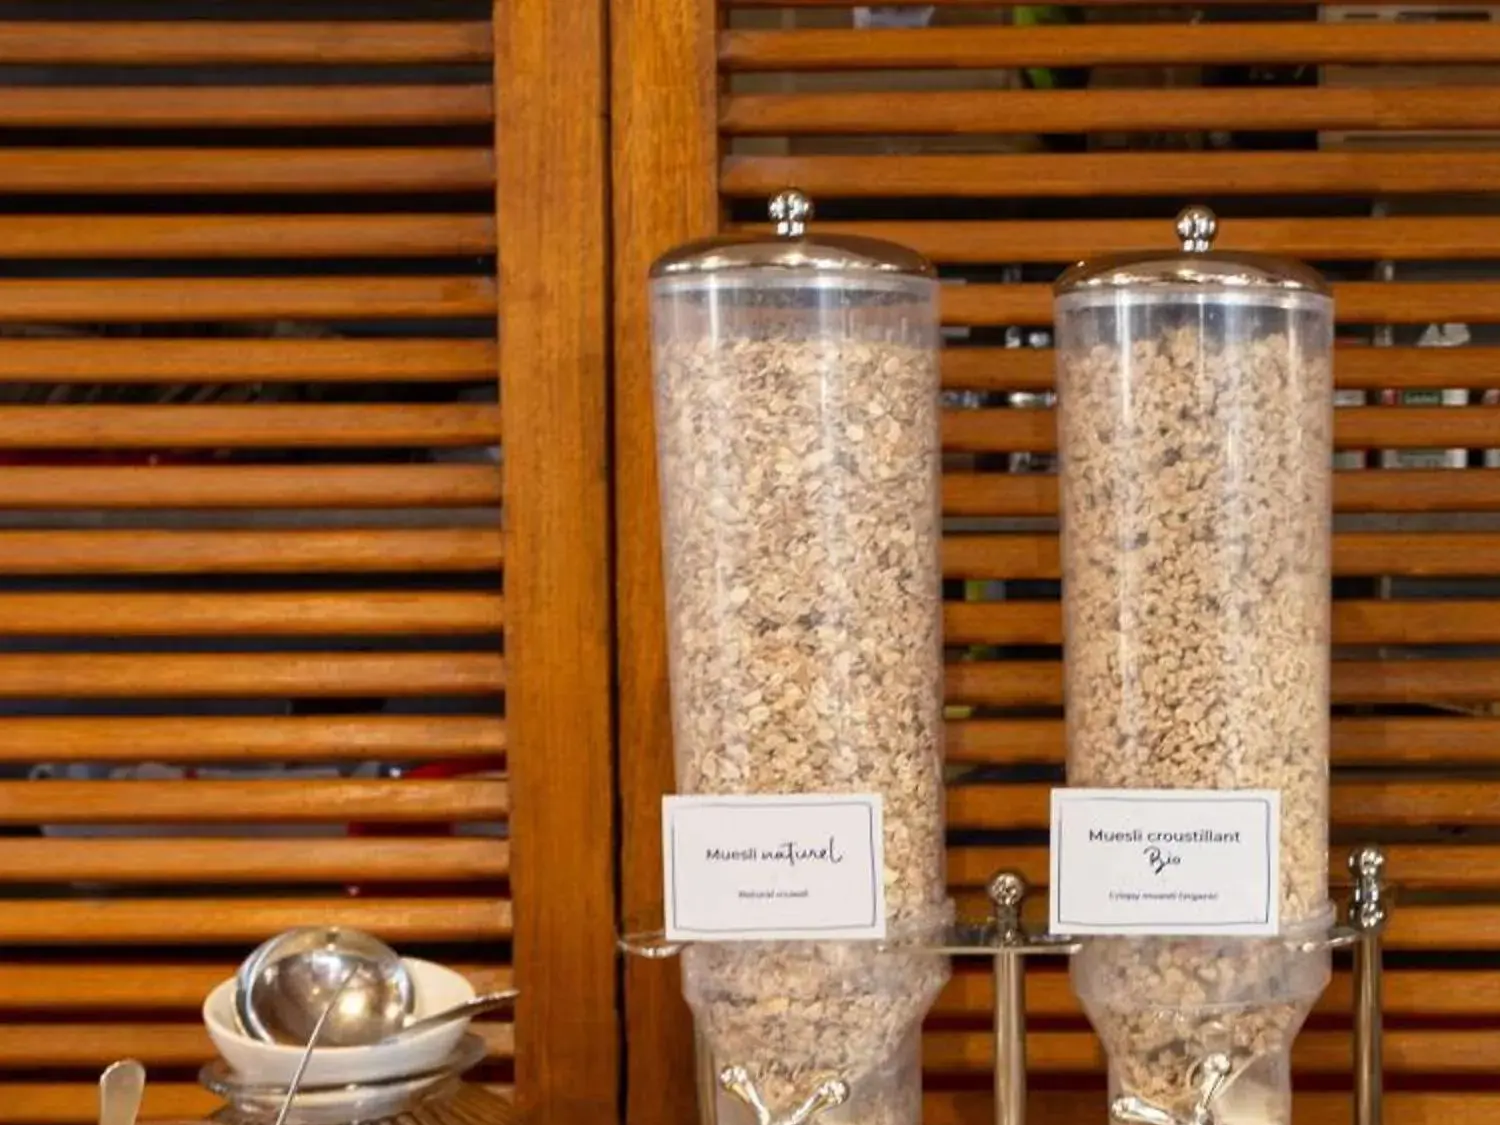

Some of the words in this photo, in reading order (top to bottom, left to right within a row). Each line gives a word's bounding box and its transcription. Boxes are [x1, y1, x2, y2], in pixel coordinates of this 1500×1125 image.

[705, 847, 757, 862] Muesli
[761, 835, 843, 867] naturel
[1088, 828, 1143, 844] Muesli
[1147, 828, 1241, 844] croustillant
[1143, 844, 1182, 876] Bio
